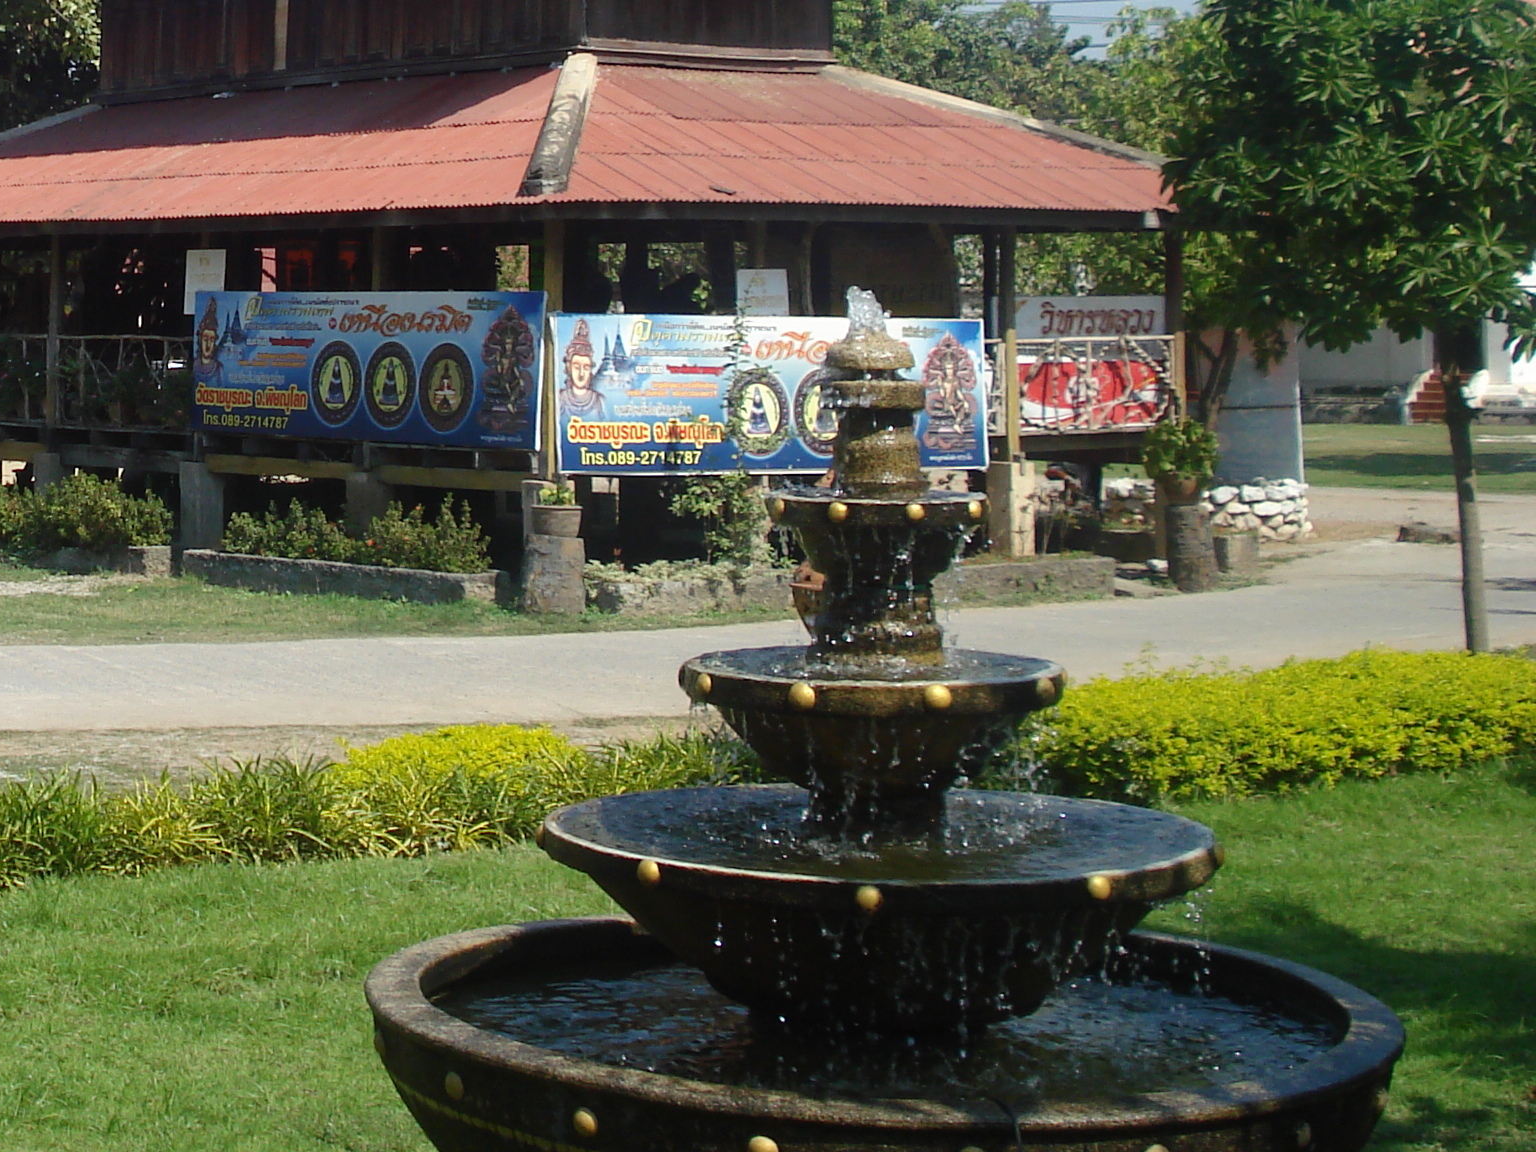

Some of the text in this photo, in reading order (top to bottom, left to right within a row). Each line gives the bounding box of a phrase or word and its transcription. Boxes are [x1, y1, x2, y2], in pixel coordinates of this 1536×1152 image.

[1040, 301, 1155, 335] วิหารหลวง
[196, 383, 307, 414] วัดราชบูรณะ จ.พิษณุโลก
[203, 409, 289, 428] โทร.089-2714787
[568, 417, 650, 447] วัดราชบูรณะ
[581, 446, 702, 465] โทร.089-2714787
